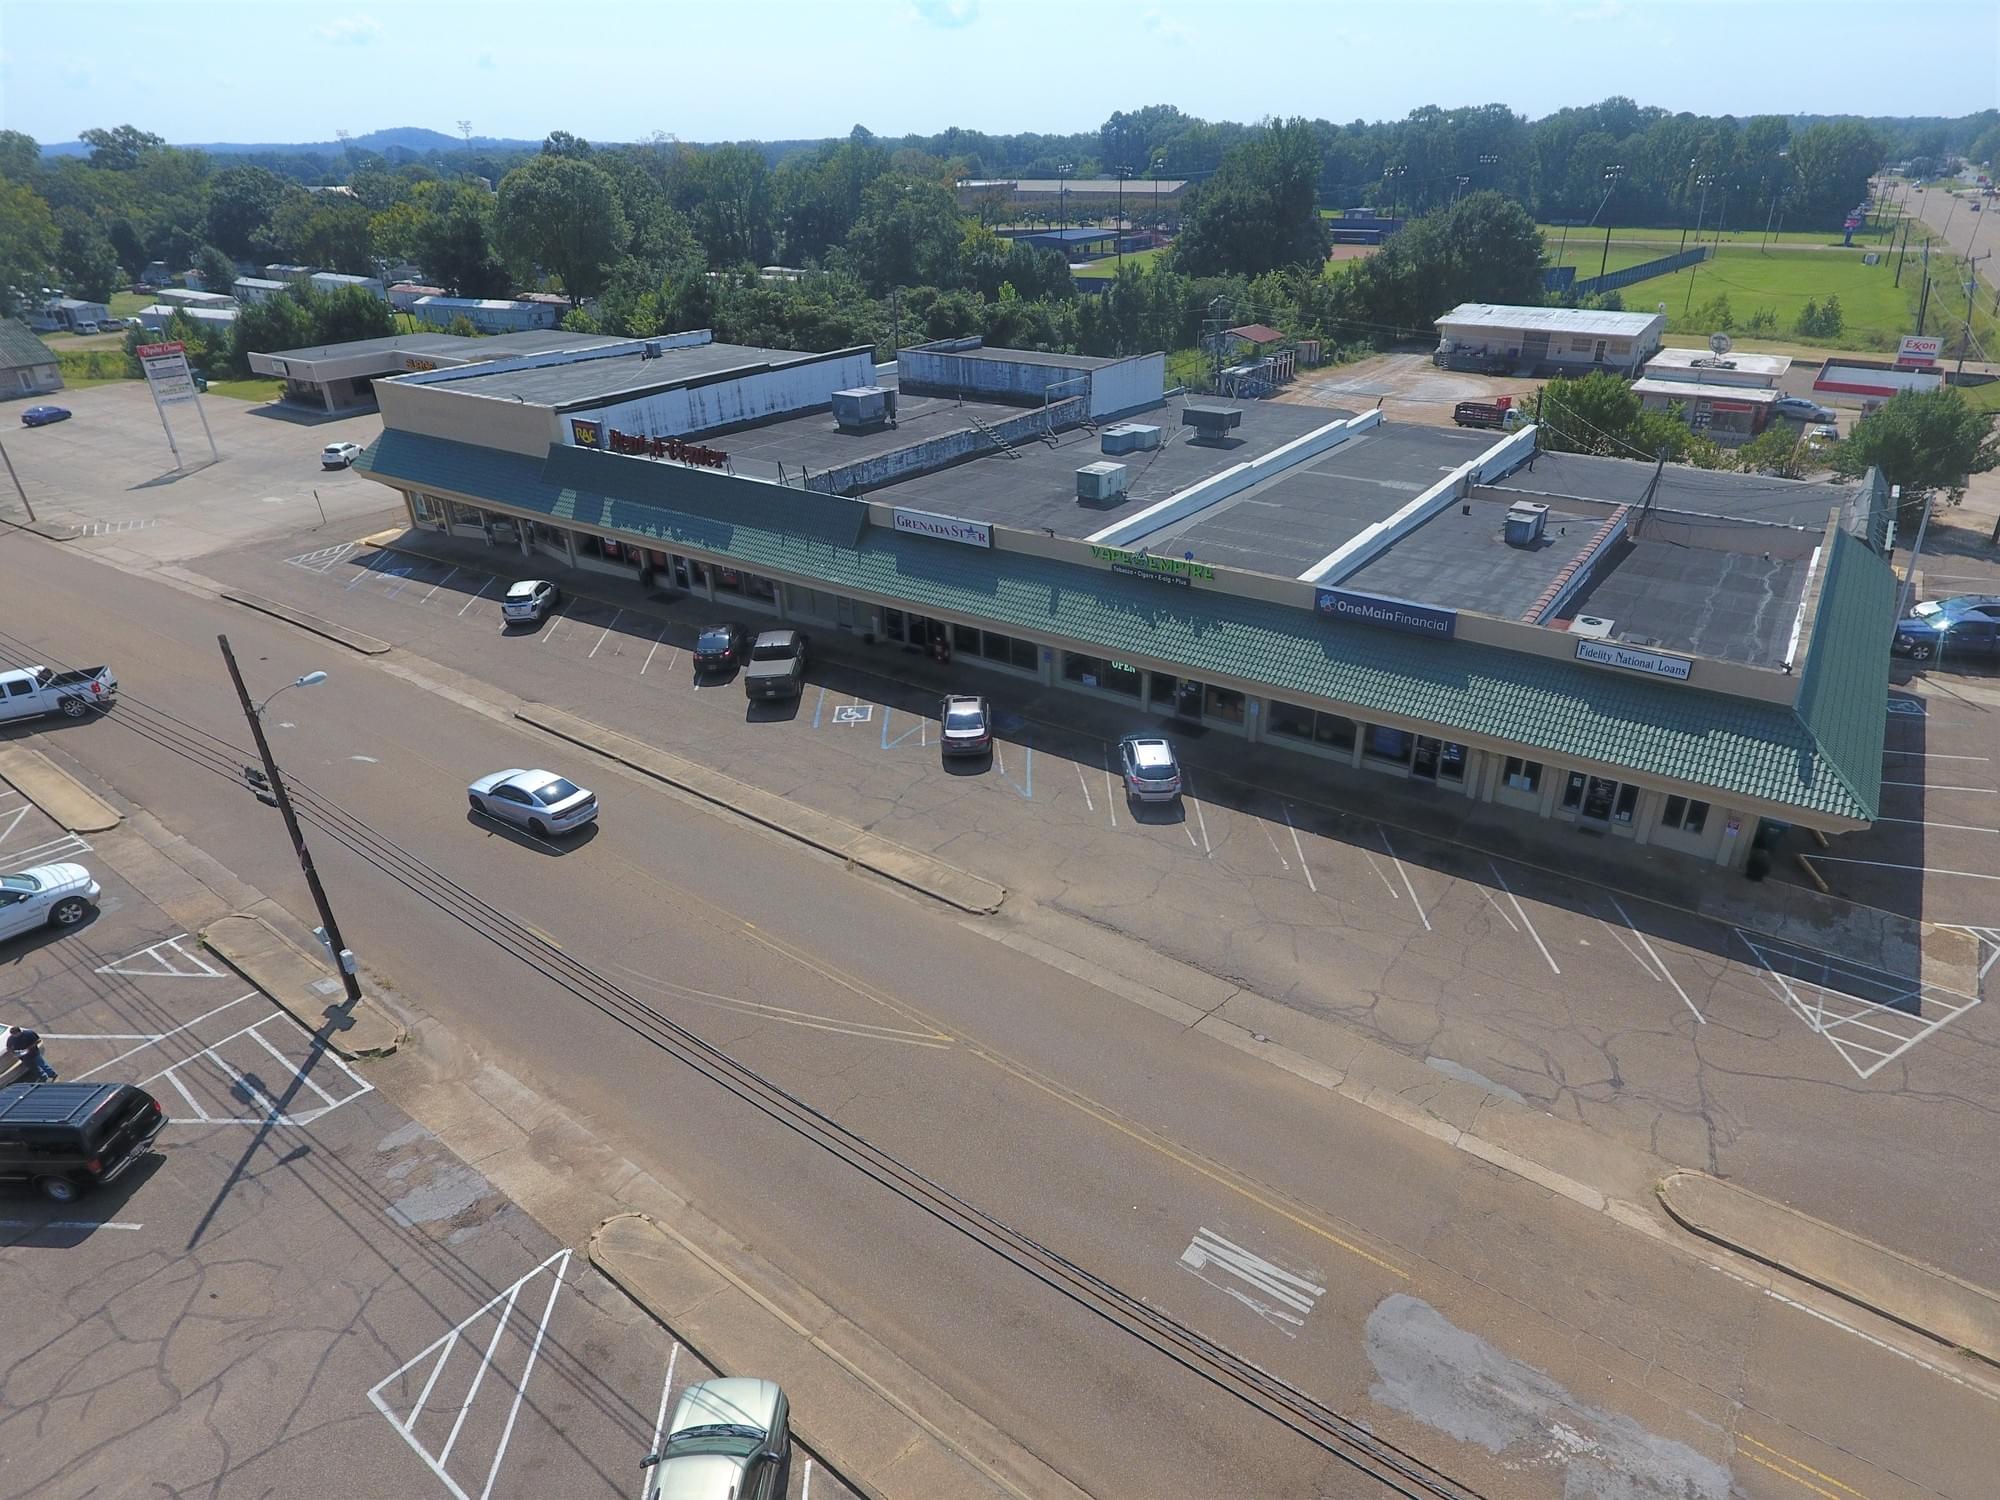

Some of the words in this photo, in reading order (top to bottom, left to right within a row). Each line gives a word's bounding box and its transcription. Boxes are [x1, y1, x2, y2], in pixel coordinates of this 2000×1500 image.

[1904, 339, 1937, 352] Exxon
[575, 427, 598, 444] RAC
[896, 514, 950, 537] GRENADA
[1090, 545, 1132, 565] VAPE
[1149, 557, 1216, 583] EMPIRE
[1137, 569, 1154, 580] Cigars
[1175, 578, 1188, 586] Plus
[1579, 644, 1613, 662] Fidelity
[1615, 651, 1655, 671] National
[1658, 659, 1687, 677] Loans
